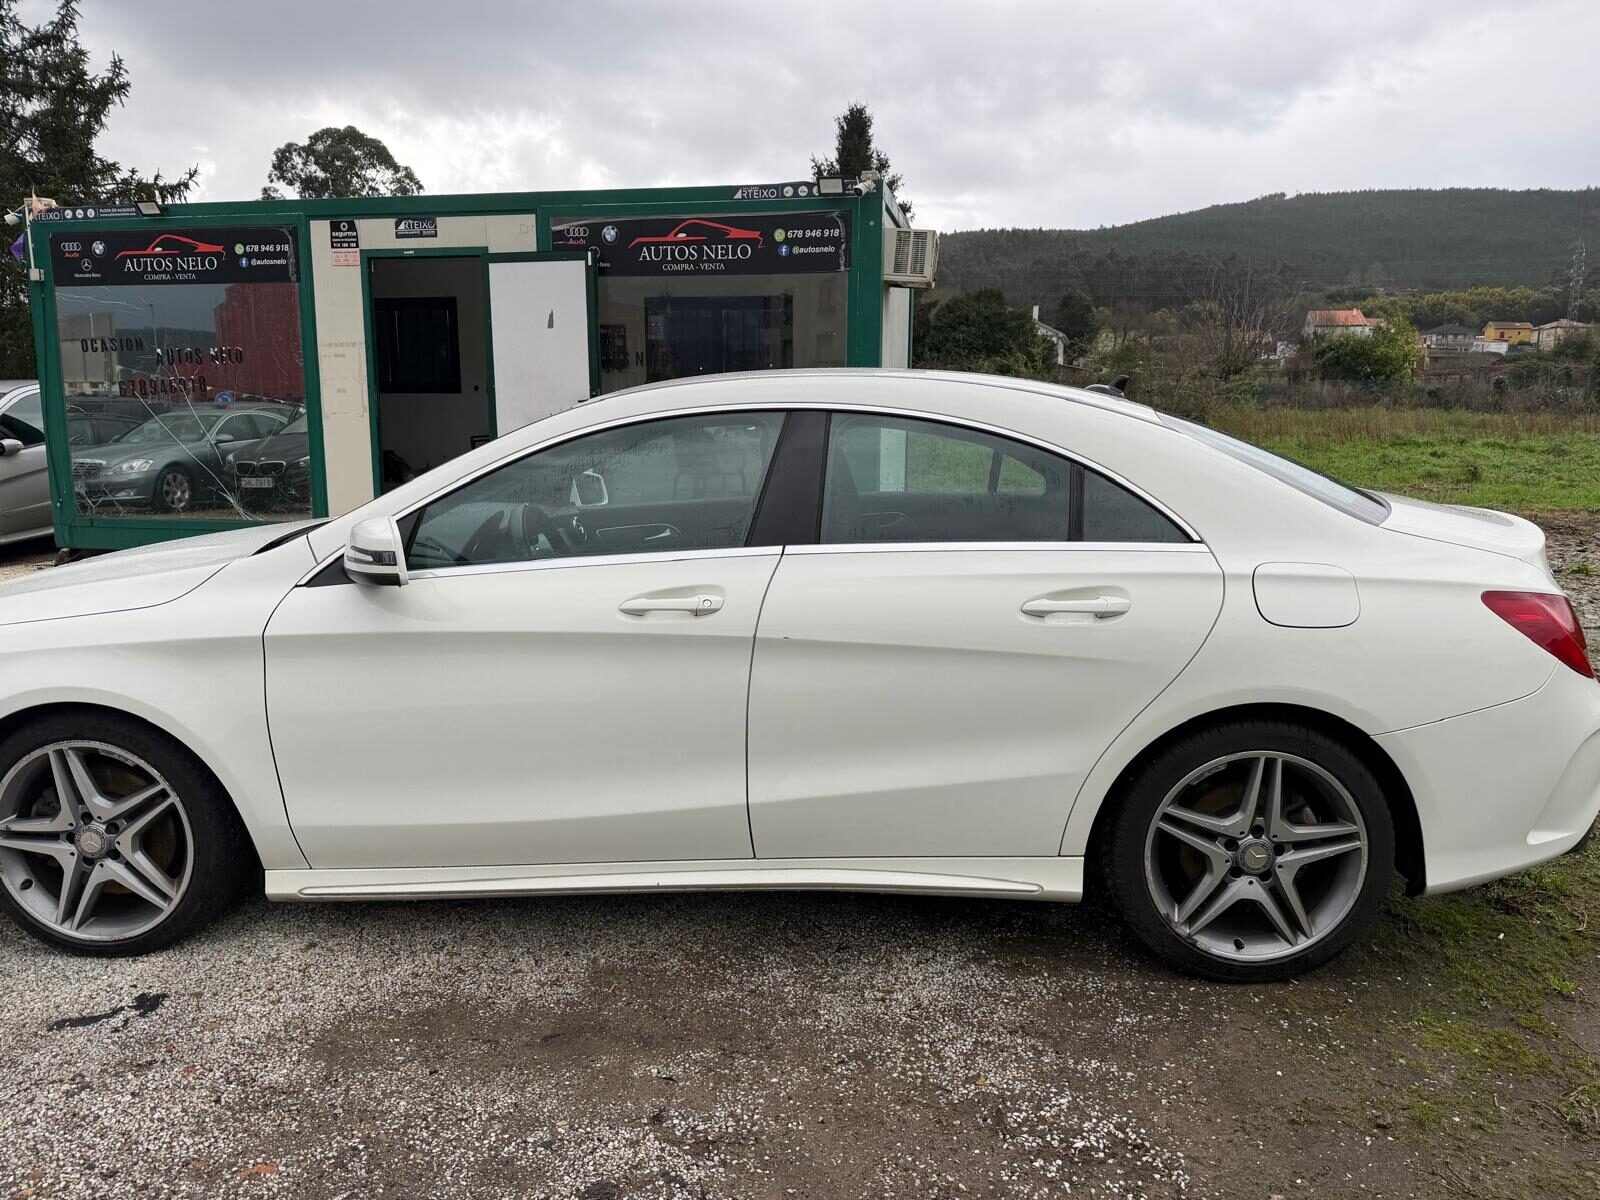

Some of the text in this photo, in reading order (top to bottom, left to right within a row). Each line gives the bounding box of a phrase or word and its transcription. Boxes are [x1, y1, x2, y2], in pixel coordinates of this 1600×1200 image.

[787, 228, 840, 239] 678 946 918
[245, 243, 290, 253] 678 946 918
[639, 244, 752, 261] AUTOS NELO
[792, 245, 835, 254] @autosnelo
[124, 256, 218, 272] AUTOS NELO
[662, 262, 695, 272] COMPRA
[700, 262, 726, 271] VENTA
[144, 273, 172, 281] COMPRA
[174, 272, 196, 280] VENTA
[80, 336, 145, 353] OCASION
[156, 348, 202, 366] AUTOS
